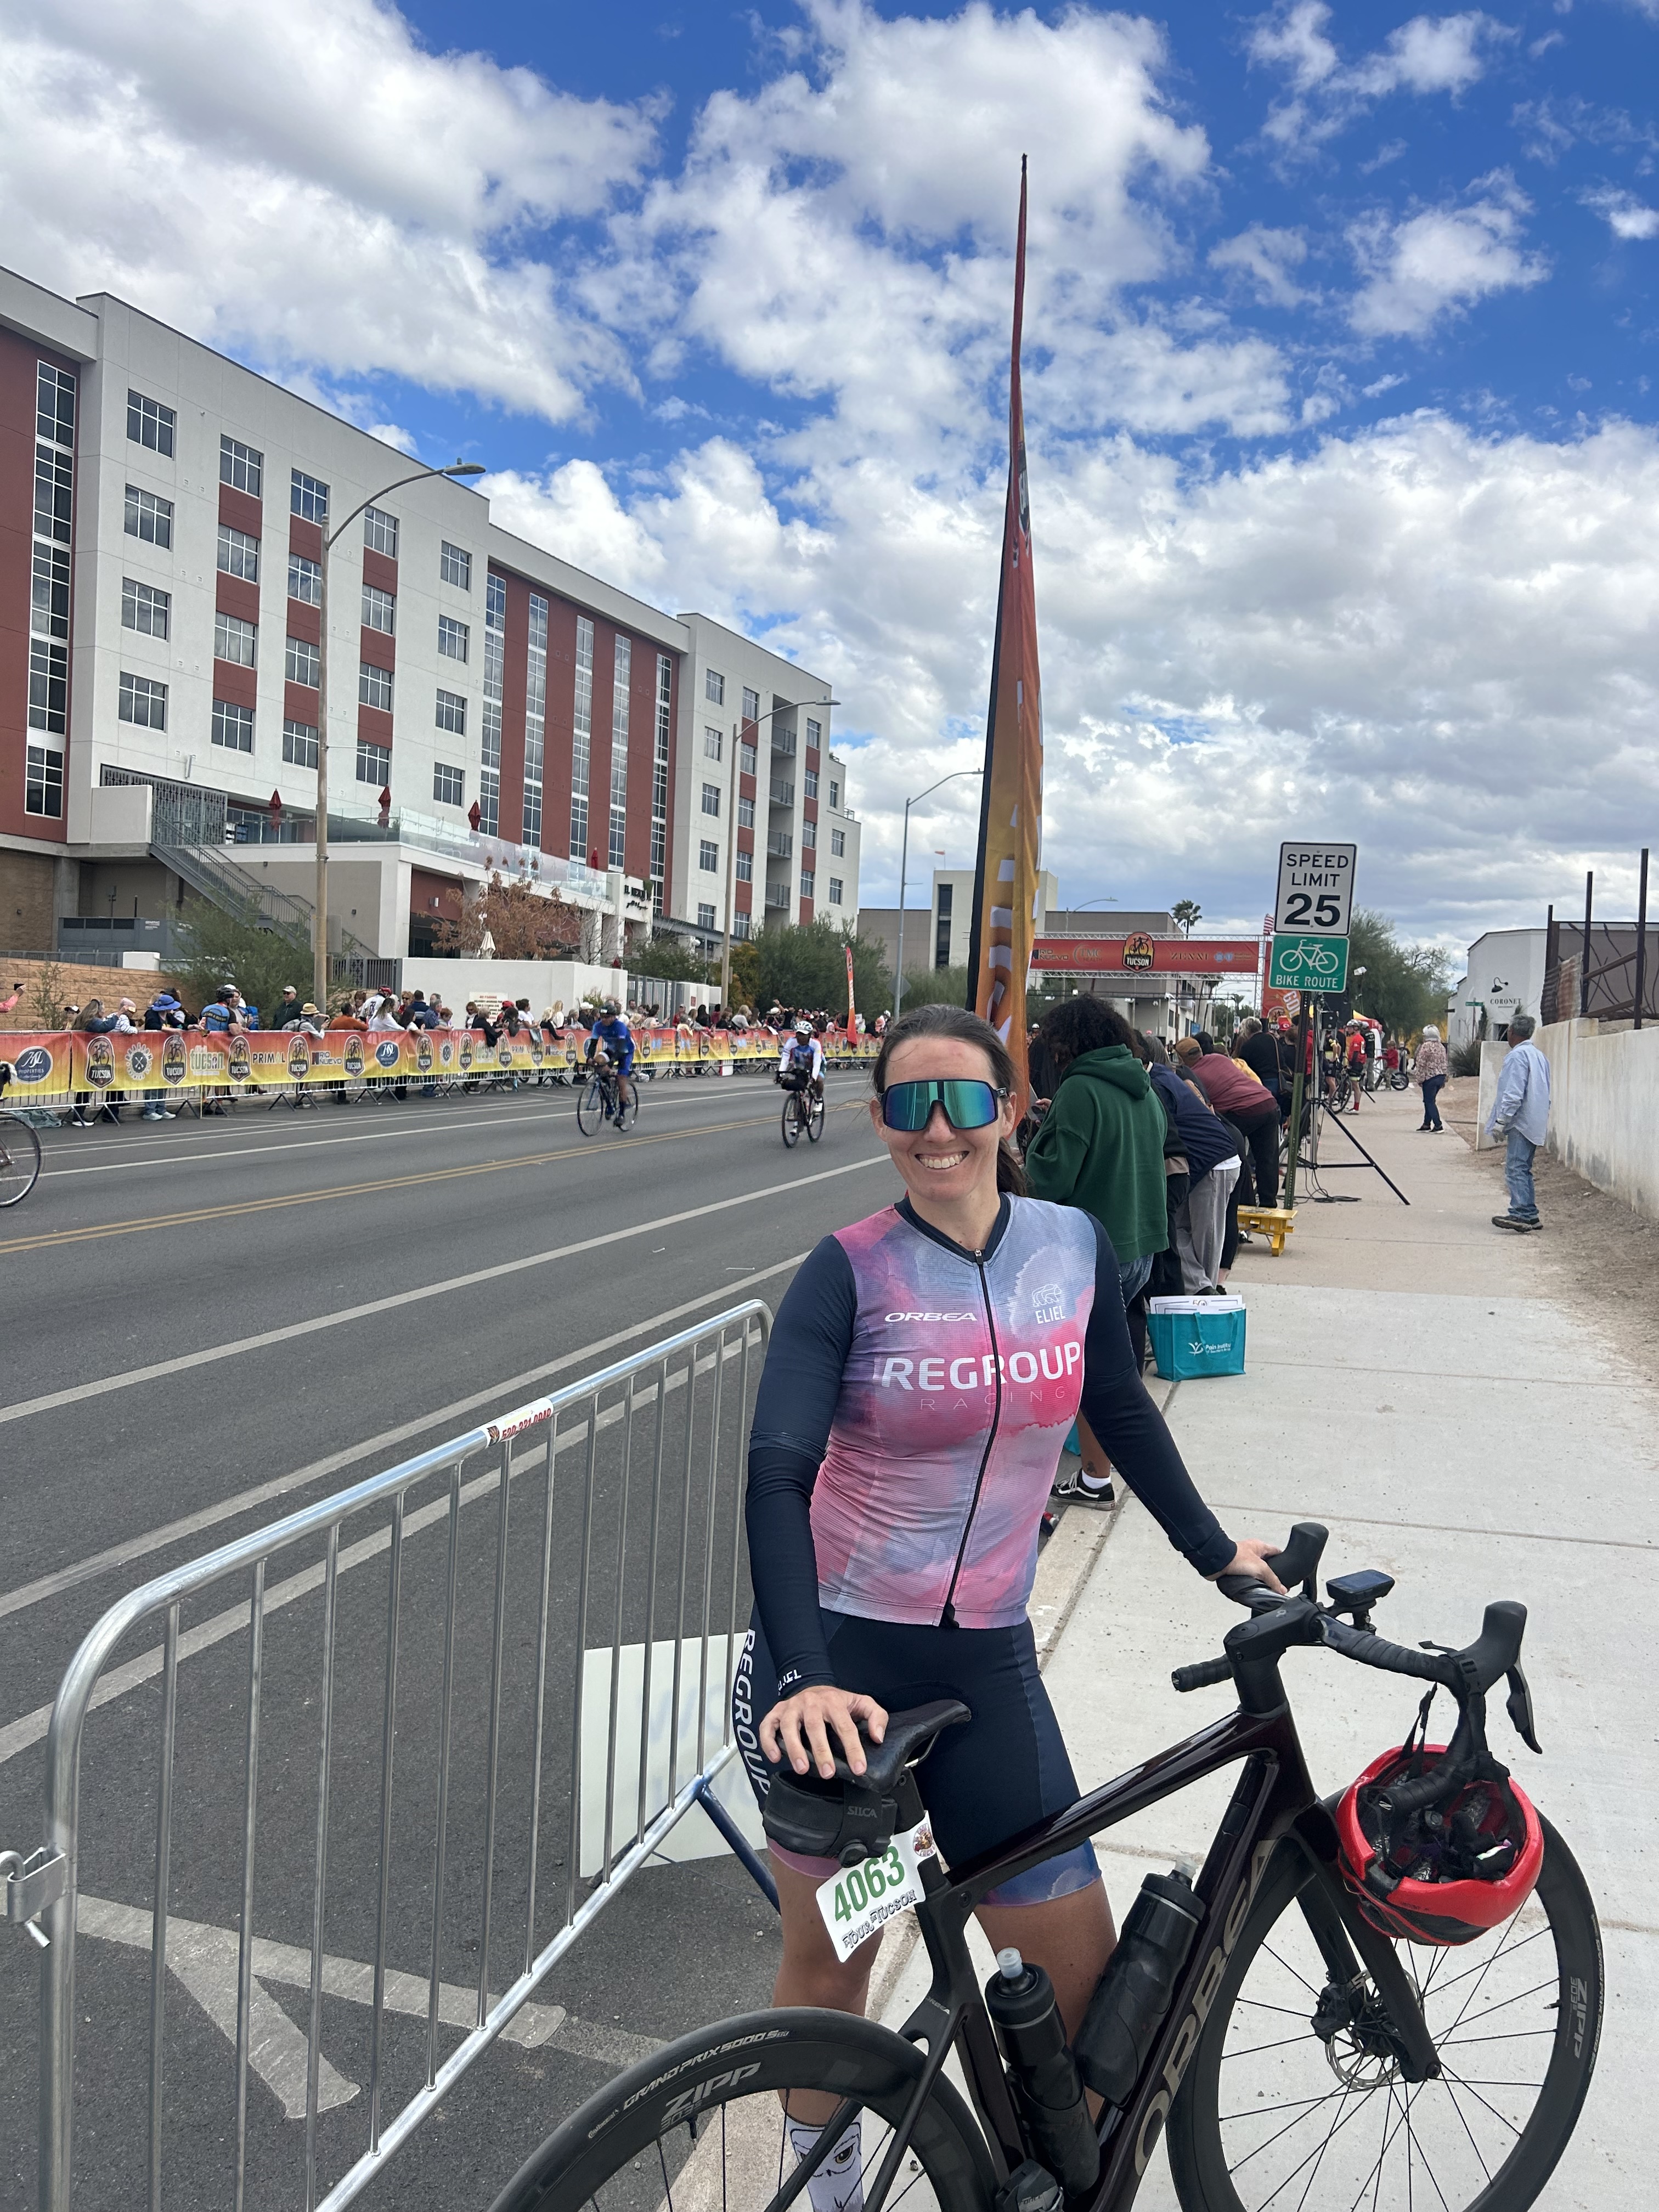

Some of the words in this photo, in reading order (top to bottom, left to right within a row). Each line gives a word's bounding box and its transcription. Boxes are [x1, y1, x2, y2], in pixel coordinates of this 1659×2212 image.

[1286, 854, 1348, 868] SPEED
[1291, 873, 1340, 887] LIMIT
[1284, 893, 1340, 927] 25
[1079, 949, 1103, 957] TMC
[1127, 957, 1149, 966] TUCSON
[1276, 974, 1299, 986] BIKE
[1305, 976, 1339, 988] ROUTE
[253, 1052, 285, 1063] PRIMAL
[92, 1069, 111, 1079] TUCSON
[166, 1068, 183, 1076] TUCSON
[231, 1065, 248, 1074] TUCSON
[884, 1312, 977, 1323] ORBEA
[1036, 1308, 1066, 1324] ELIEL
[881, 1341, 1081, 1391] REGROUP
[920, 1386, 1065, 1410] RACING
[735, 1628, 771, 1796] REGROUP
[847, 1805, 877, 1818] SILCA
[835, 1846, 905, 1922] 4063
[842, 1919, 874, 1949] TOUR
[869, 1889, 917, 1923] TUCSON
[1573, 1978, 1588, 2059] ZIPP
[623, 2065, 680, 2111] GRAND
[678, 2046, 722, 2073] PRIX
[721, 2033, 765, 2052] 5000
[661, 2062, 761, 2121] ZIPP
